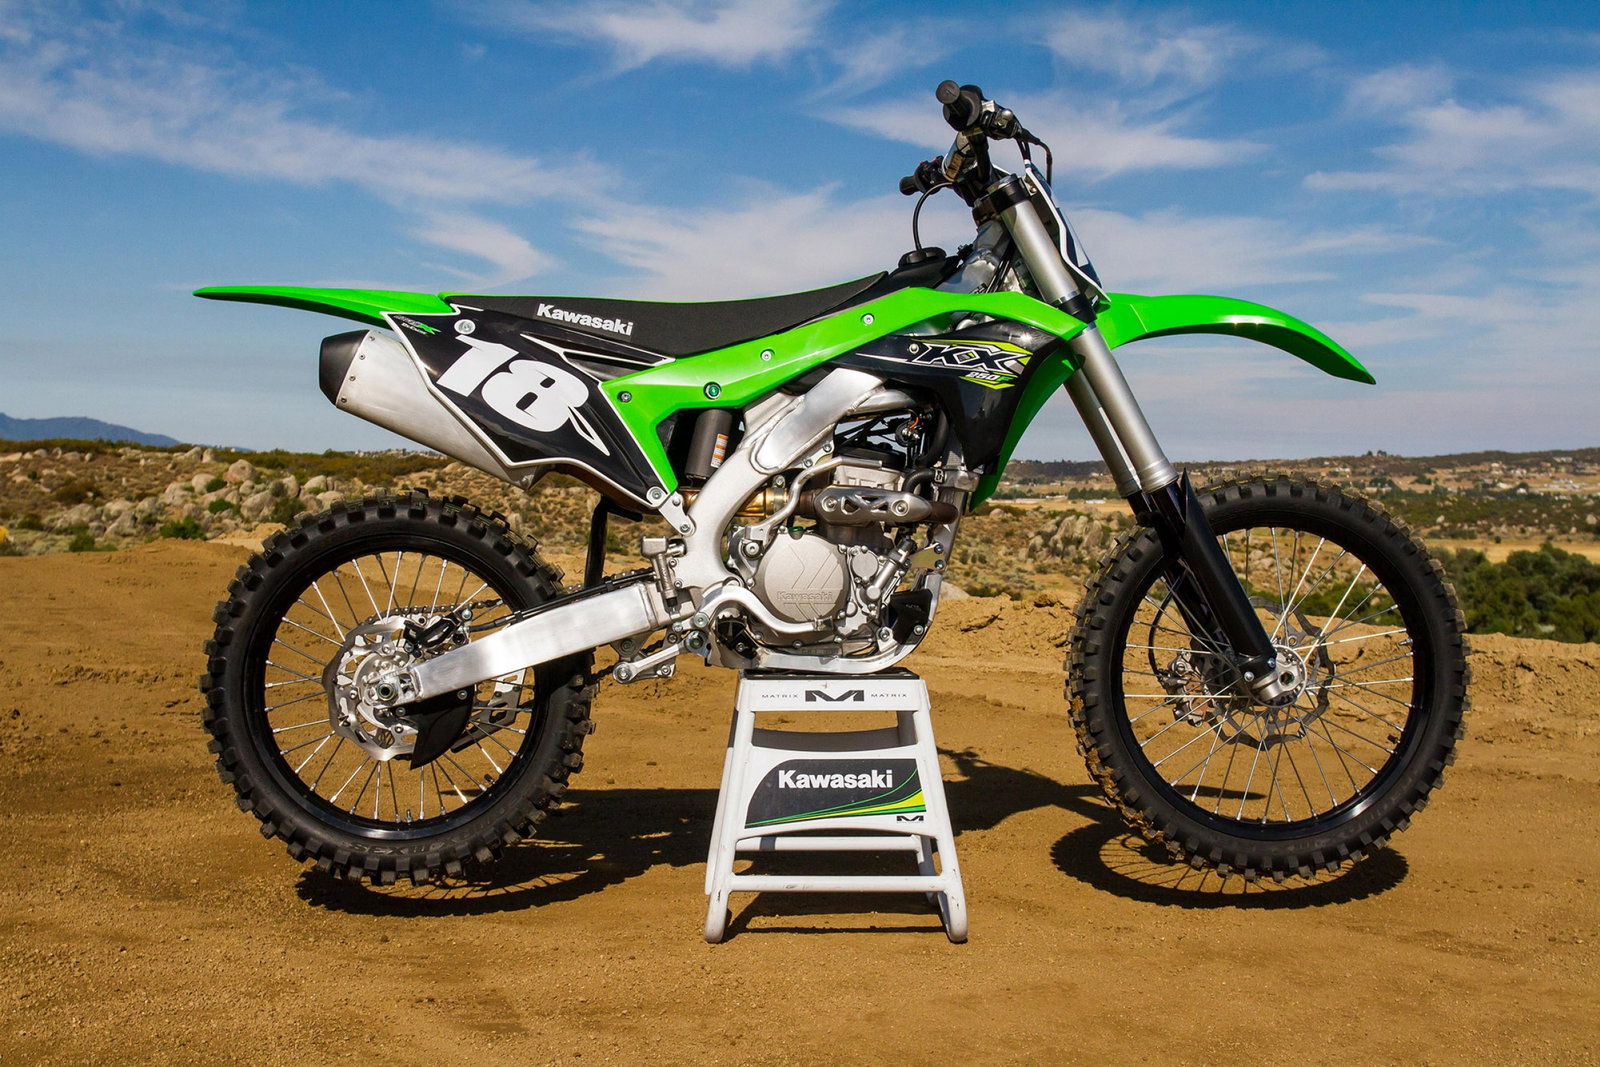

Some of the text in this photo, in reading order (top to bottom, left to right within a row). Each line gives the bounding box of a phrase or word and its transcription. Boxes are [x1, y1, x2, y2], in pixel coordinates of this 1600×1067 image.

[537, 303, 634, 336] Kawasaki
[911, 342, 1028, 374] KX
[437, 334, 590, 433] 18
[965, 371, 1014, 382] 250F
[776, 590, 833, 601] Kawasaki
[779, 769, 893, 789] Kawasaki
